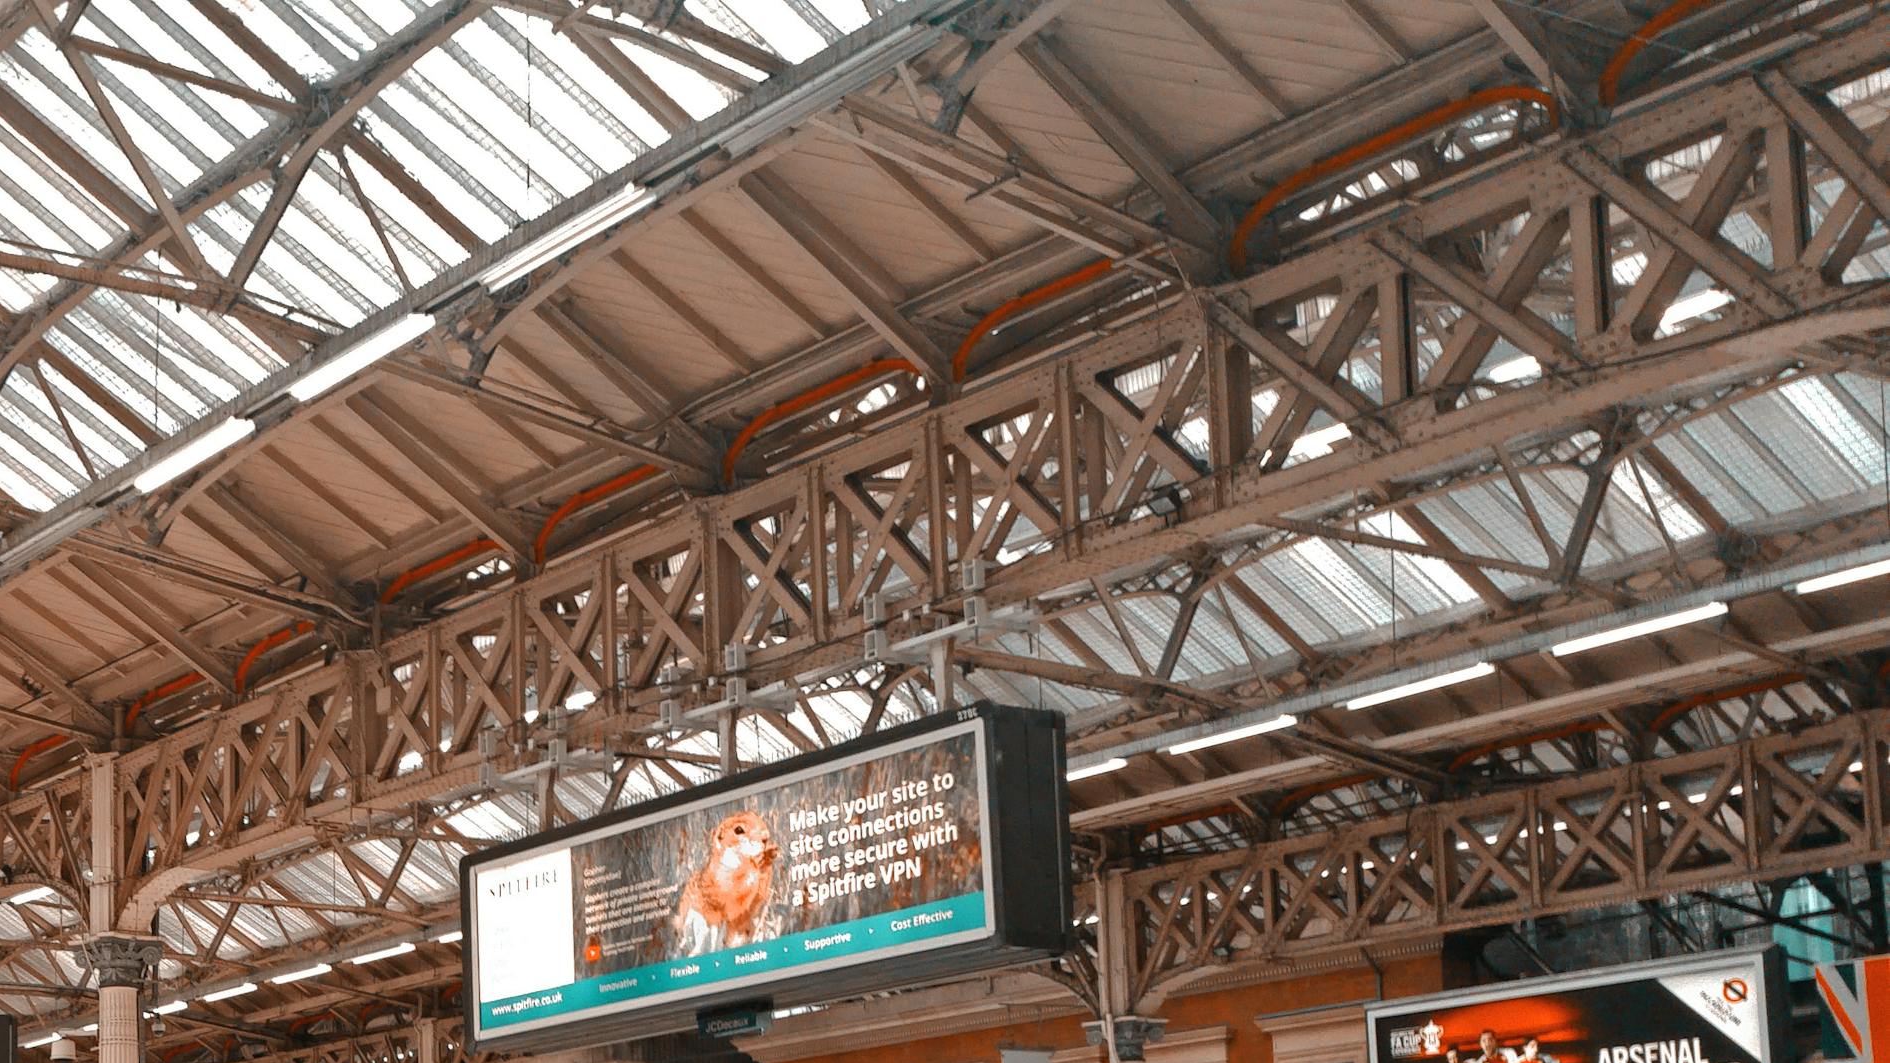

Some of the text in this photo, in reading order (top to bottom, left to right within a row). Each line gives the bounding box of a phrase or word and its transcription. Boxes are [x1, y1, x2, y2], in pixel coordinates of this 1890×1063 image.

[789, 772, 954, 833] Make your site to
[789, 801, 945, 858] site connections
[790, 821, 959, 882] more secure with
[791, 855, 922, 907] a Spitfire VPN
[598, 908, 954, 993] Innovative Flexible Reliable Supportive Cost Effective
[491, 991, 563, 1017] www.spitfire.co.uk
[704, 1014, 750, 1035] JCDecaux
